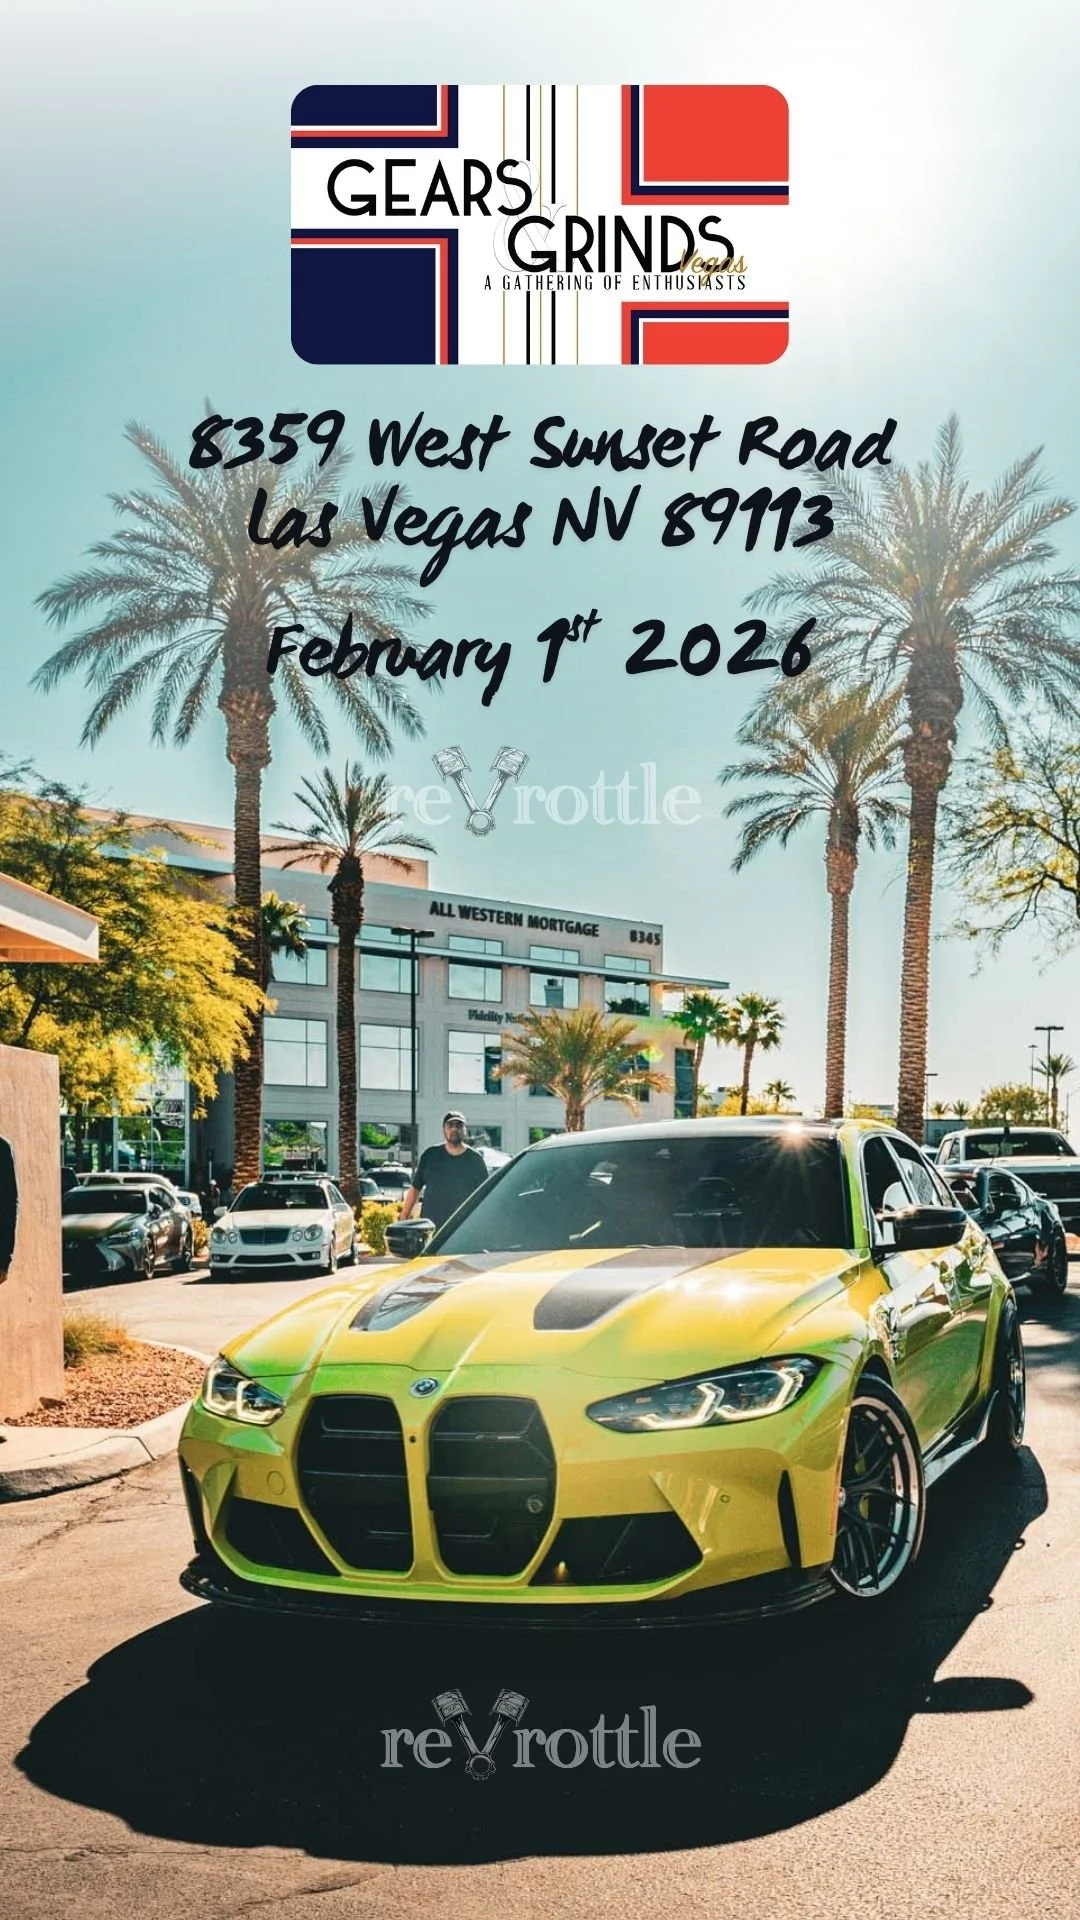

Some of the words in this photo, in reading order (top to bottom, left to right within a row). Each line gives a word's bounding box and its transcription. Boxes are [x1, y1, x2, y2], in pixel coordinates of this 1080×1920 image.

[429, 900, 456, 918] ALL
[458, 904, 524, 927] WESTERN
[527, 915, 600, 938] MORTGAGE
[629, 929, 662, 946] 8345
